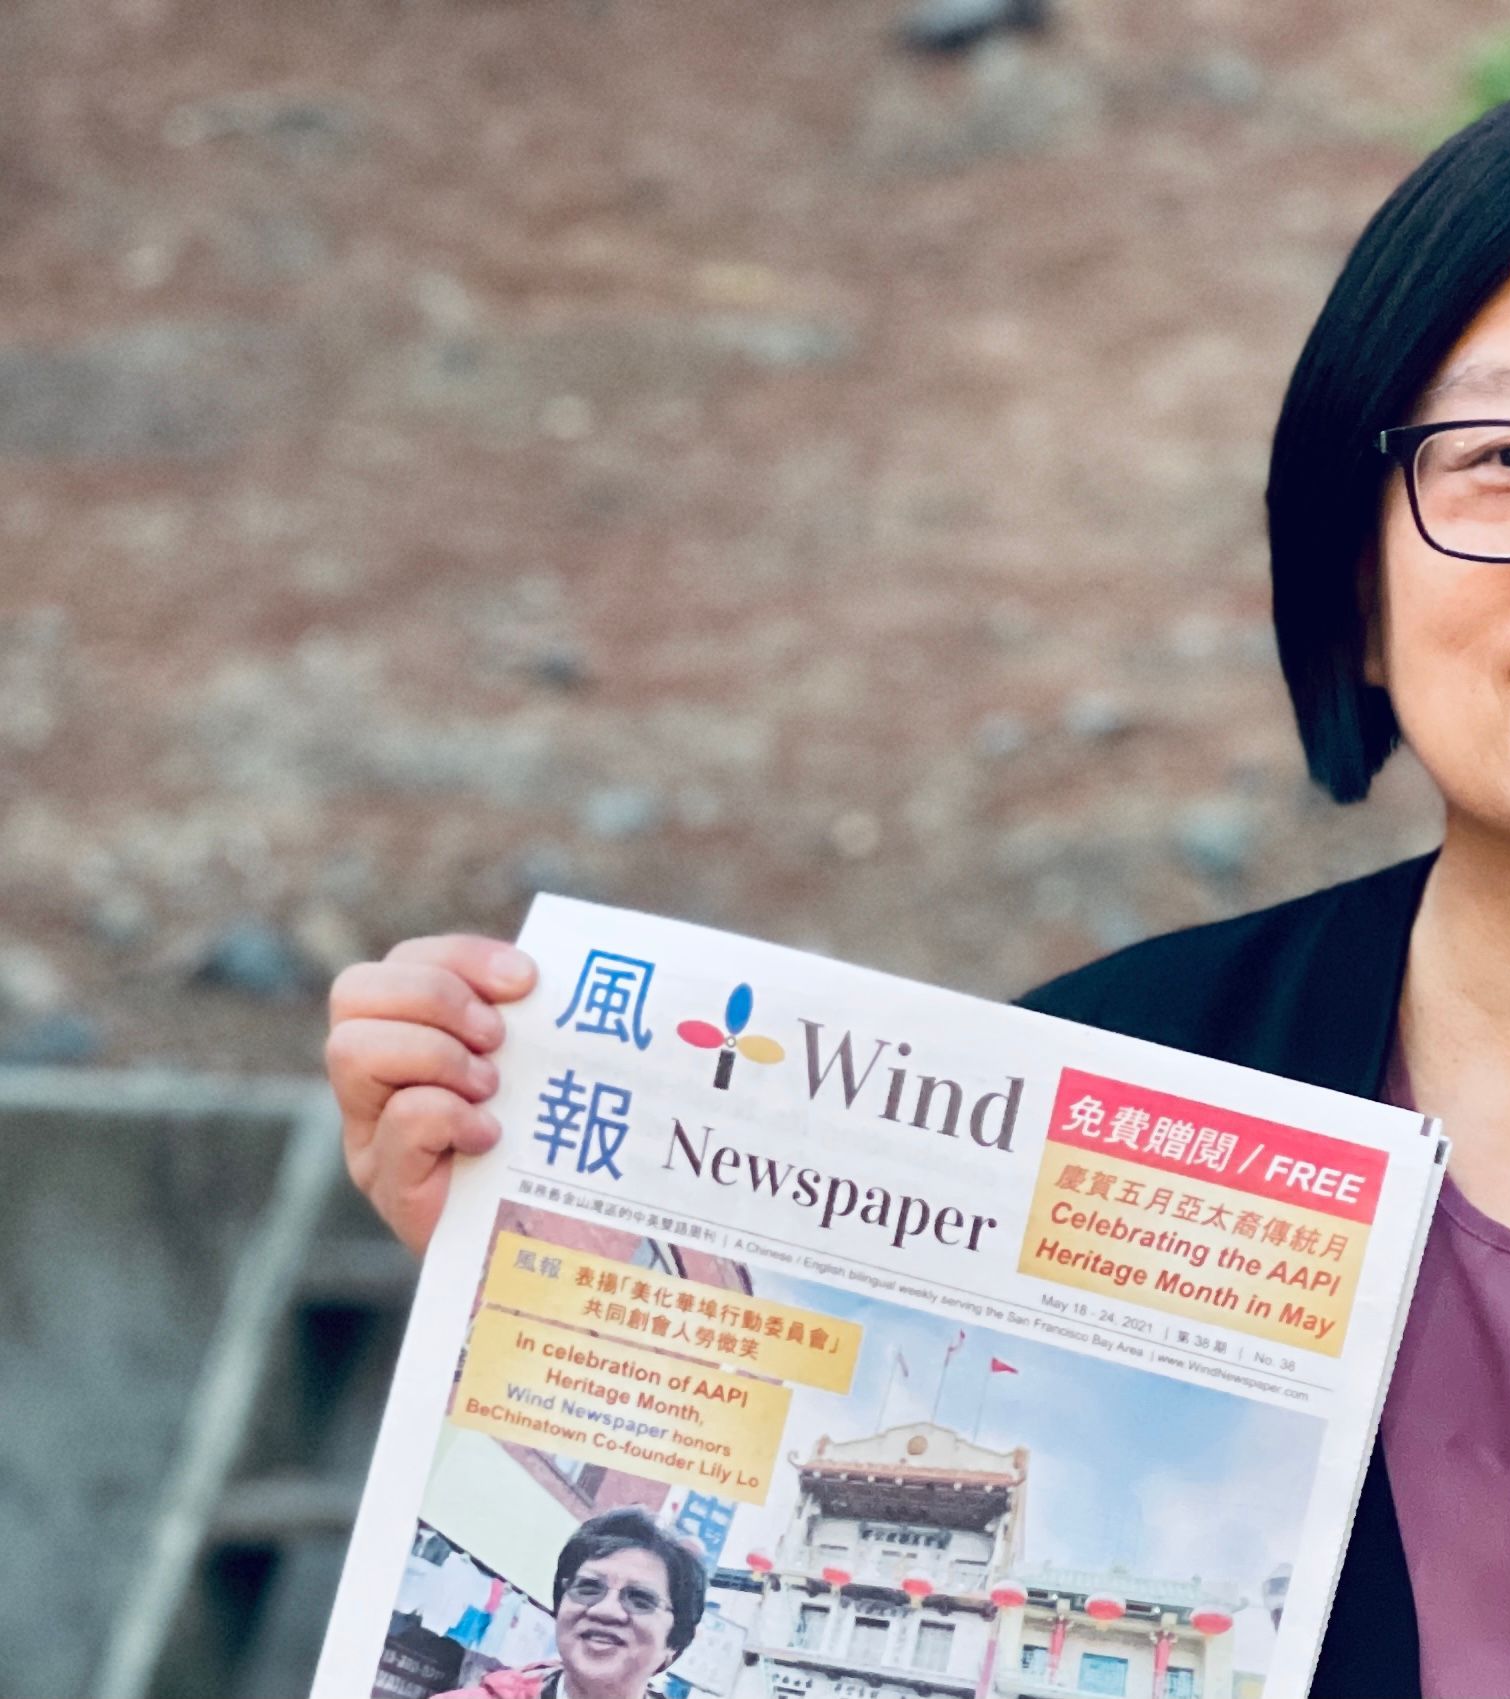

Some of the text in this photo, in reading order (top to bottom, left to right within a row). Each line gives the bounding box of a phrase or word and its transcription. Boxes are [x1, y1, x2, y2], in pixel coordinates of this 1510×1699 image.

[797, 1017, 1026, 1153] Wind
[661, 1117, 998, 1253] Newspaper
[1061, 1095, 1239, 1173] 免費贈閱
[1263, 1155, 1365, 1204] FREE
[1050, 1201, 1343, 1297] Celebrating the AAPI
[1054, 1164, 1349, 1262] 慶賀五月亞太裔傳統月
[512, 1249, 563, 1280] 風報
[746, 1242, 793, 1264] Chinese
[803, 1257, 846, 1278] English
[849, 1269, 896, 1291] bilingual
[899, 1285, 939, 1304] weekly
[941, 1296, 982, 1317] serving
[986, 1306, 1004, 1320] the
[1007, 1310, 1030, 1326] San
[1033, 1318, 1089, 1343] Francisco
[1091, 1334, 1114, 1351] Bay
[1116, 1341, 1144, 1357] Area
[1035, 1238, 1335, 1340] Heritage Month in May
[1041, 1294, 1069, 1314] May
[1073, 1302, 1088, 1316] 18
[1122, 1315, 1153, 1332] 2021
[1193, 1335, 1211, 1348] 38
[516, 1332, 749, 1408] In celebration of AAPI
[545, 1367, 705, 1426] Heritage Month,
[465, 1397, 760, 1488] BeChinatown Co-founder Lily Lo
[506, 1384, 732, 1457] Wind Newspaper honors
